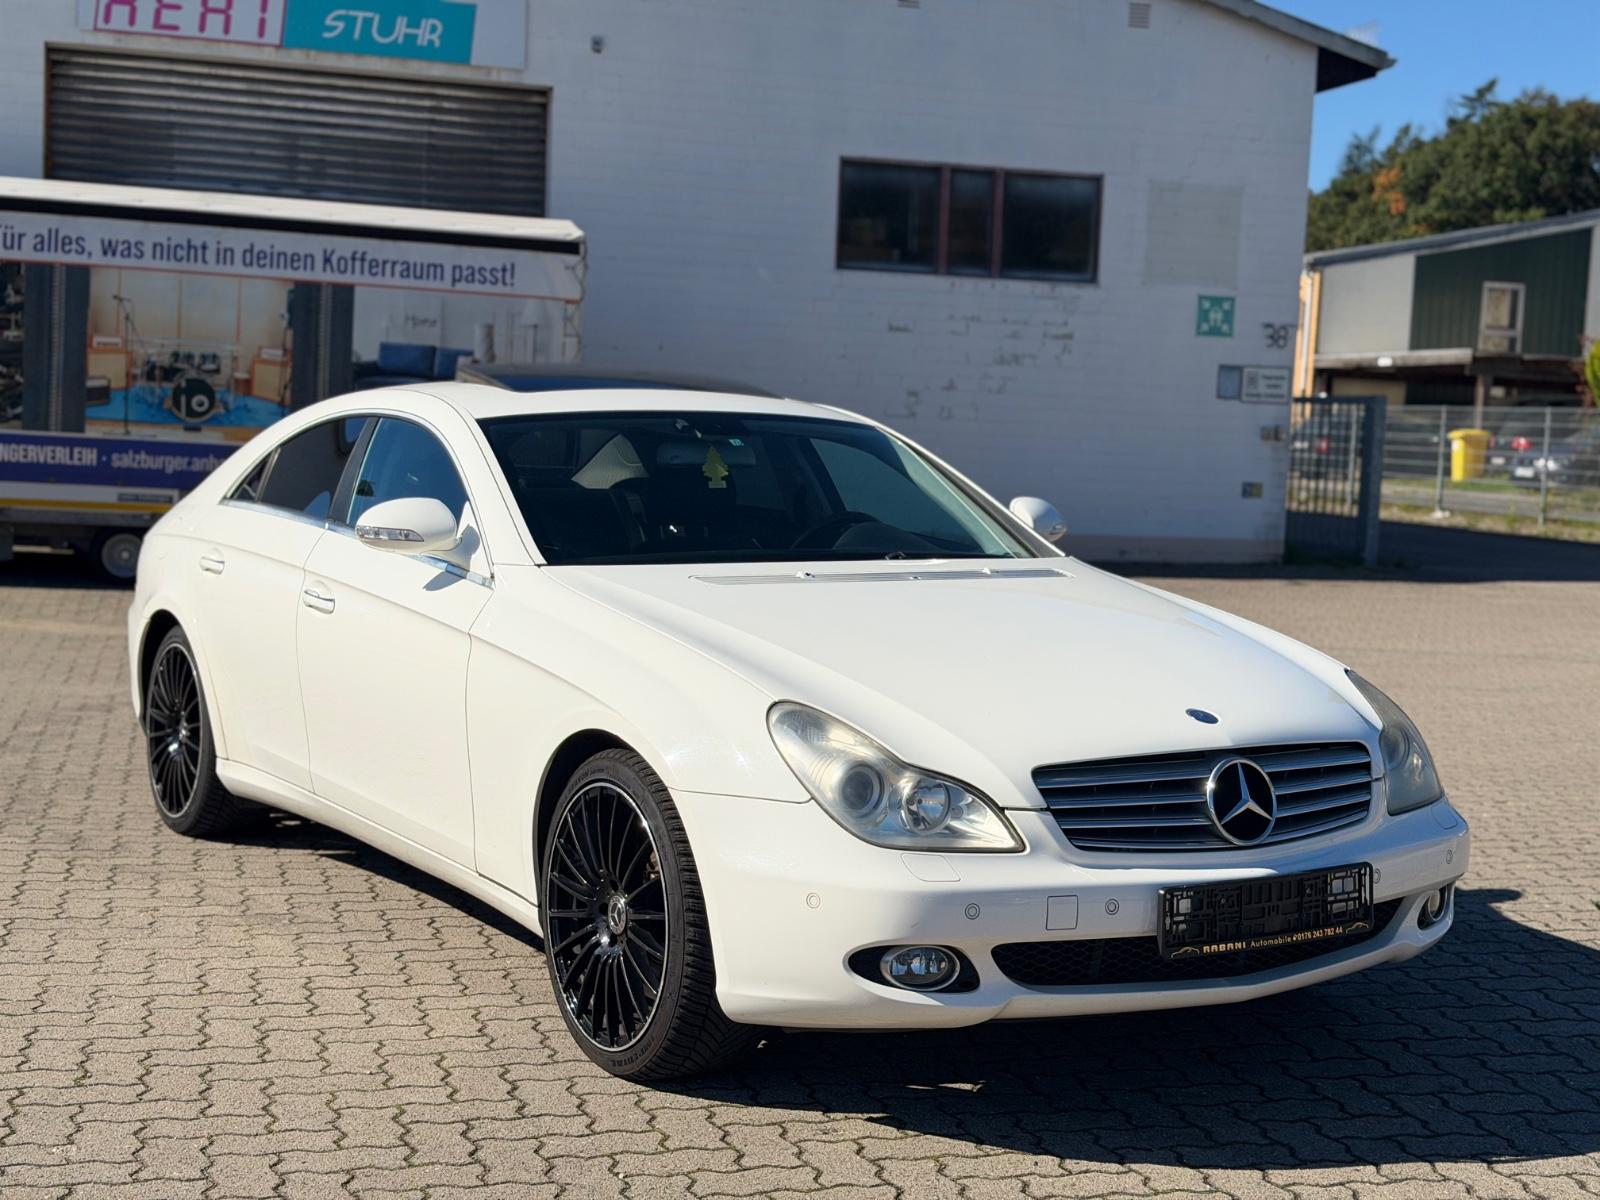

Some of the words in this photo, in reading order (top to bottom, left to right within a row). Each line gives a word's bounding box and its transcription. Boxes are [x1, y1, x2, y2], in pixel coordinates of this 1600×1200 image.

[322, 9, 443, 48] STUHR
[0, 224, 26, 251] ür
[33, 228, 93, 259] alles,
[101, 237, 145, 260] was
[152, 236, 209, 264] nicht
[216, 240, 235, 266] in
[242, 243, 315, 273] deinen
[322, 248, 445, 282] Kofferraum
[451, 262, 516, 288] passt!
[1250, 935, 1292, 948] Automobile
